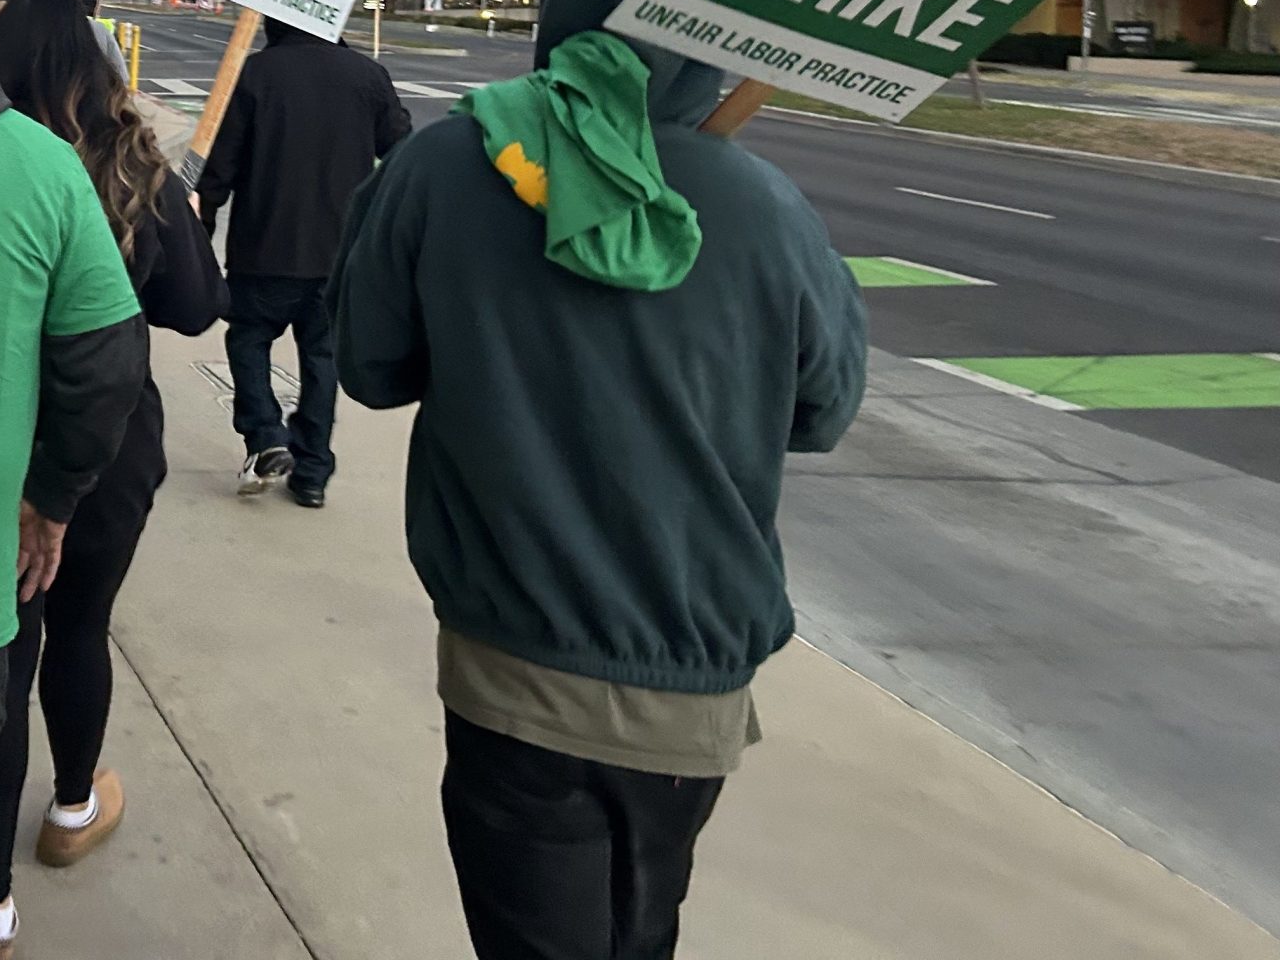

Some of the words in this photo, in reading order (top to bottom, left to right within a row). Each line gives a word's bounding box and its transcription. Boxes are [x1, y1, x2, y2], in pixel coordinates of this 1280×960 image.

[634, 0, 724, 45] UNFAIR
[721, 31, 801, 72] LABOR
[798, 58, 917, 104] PRACTICE
